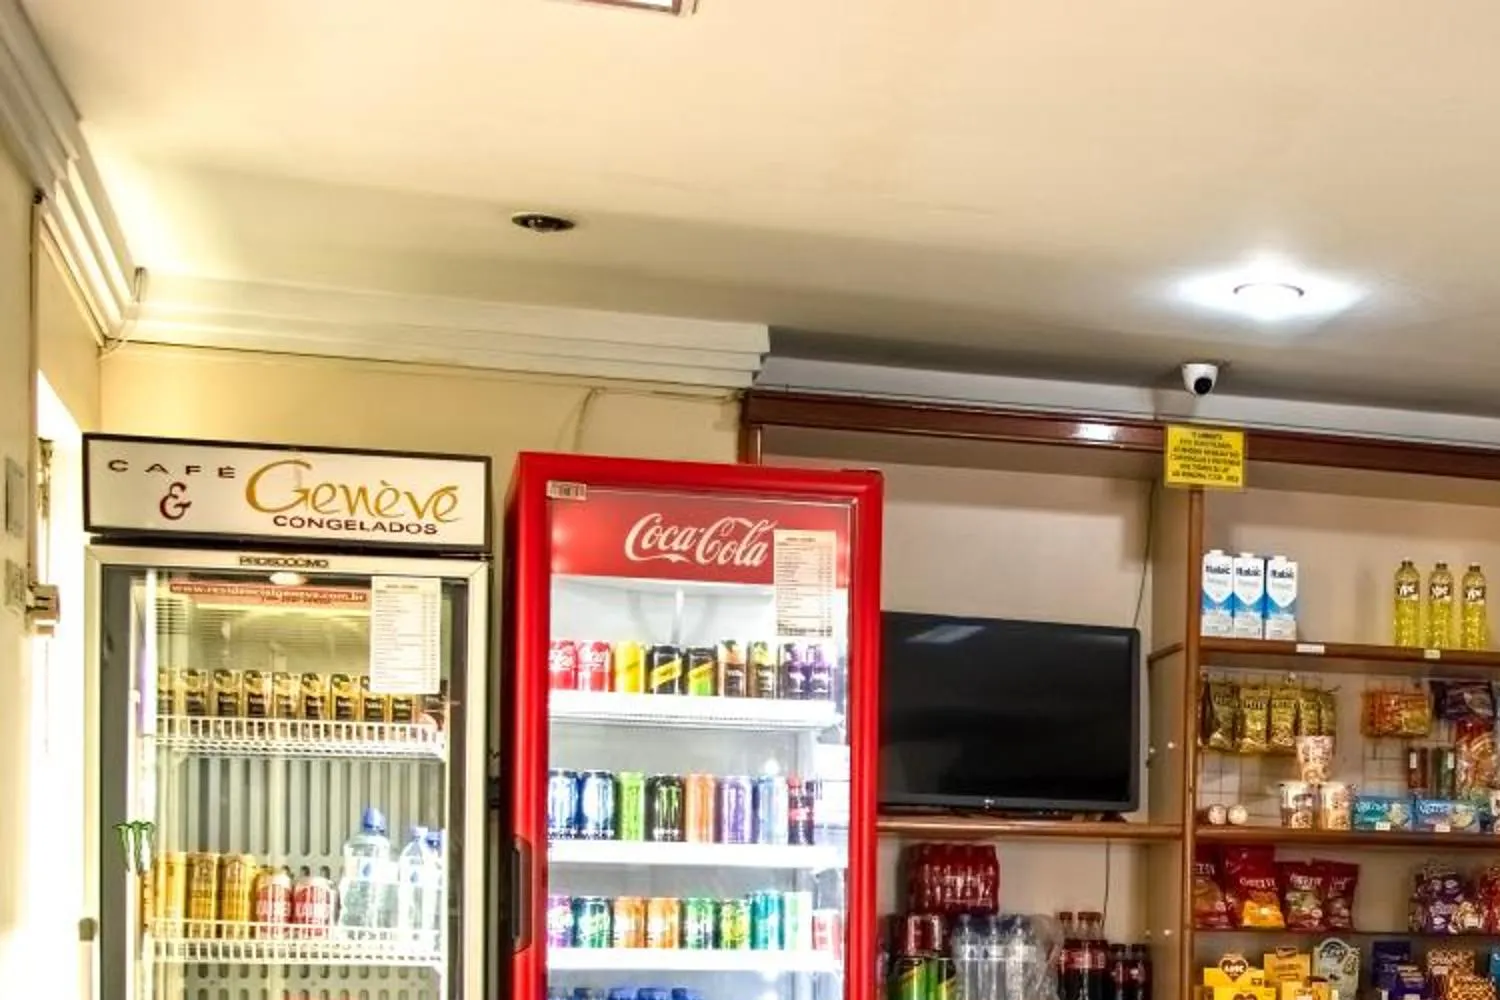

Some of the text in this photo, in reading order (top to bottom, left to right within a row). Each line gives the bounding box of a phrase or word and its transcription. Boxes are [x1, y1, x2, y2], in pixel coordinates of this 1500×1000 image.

[108, 459, 236, 479] CAFÉ
[272, 514, 439, 535] CONGELADOS
[625, 513, 777, 566] Coca-Cola
